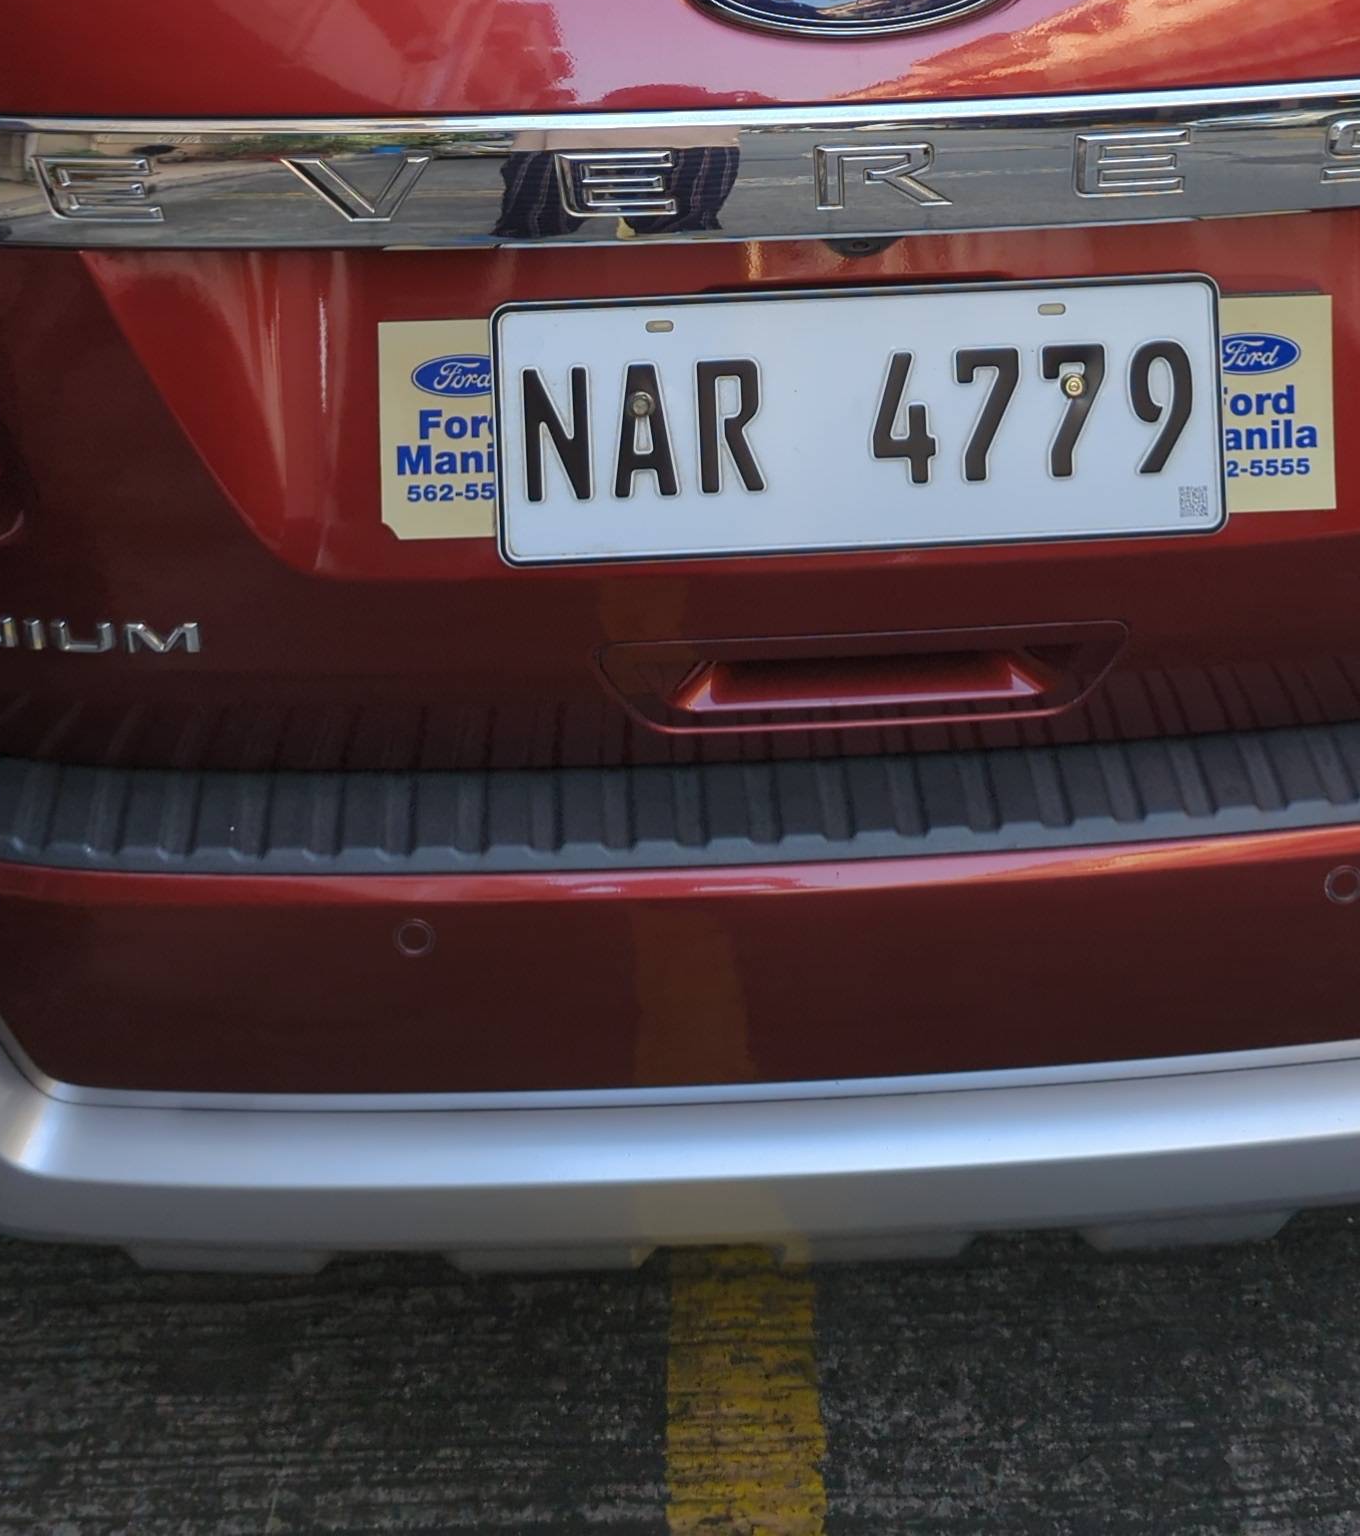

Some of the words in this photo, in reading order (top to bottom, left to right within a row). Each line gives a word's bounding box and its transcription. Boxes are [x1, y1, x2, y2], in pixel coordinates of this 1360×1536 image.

[1222, 339, 1280, 368] Ford
[1223, 384, 1296, 417] ord
[418, 408, 495, 441] For
[522, 358, 767, 503] NAR
[871, 339, 1194, 485] 4779
[1225, 419, 1318, 452] anila
[396, 441, 496, 477] Mani
[1226, 457, 1311, 488] 2-5555
[406, 482, 497, 503] 562-55
